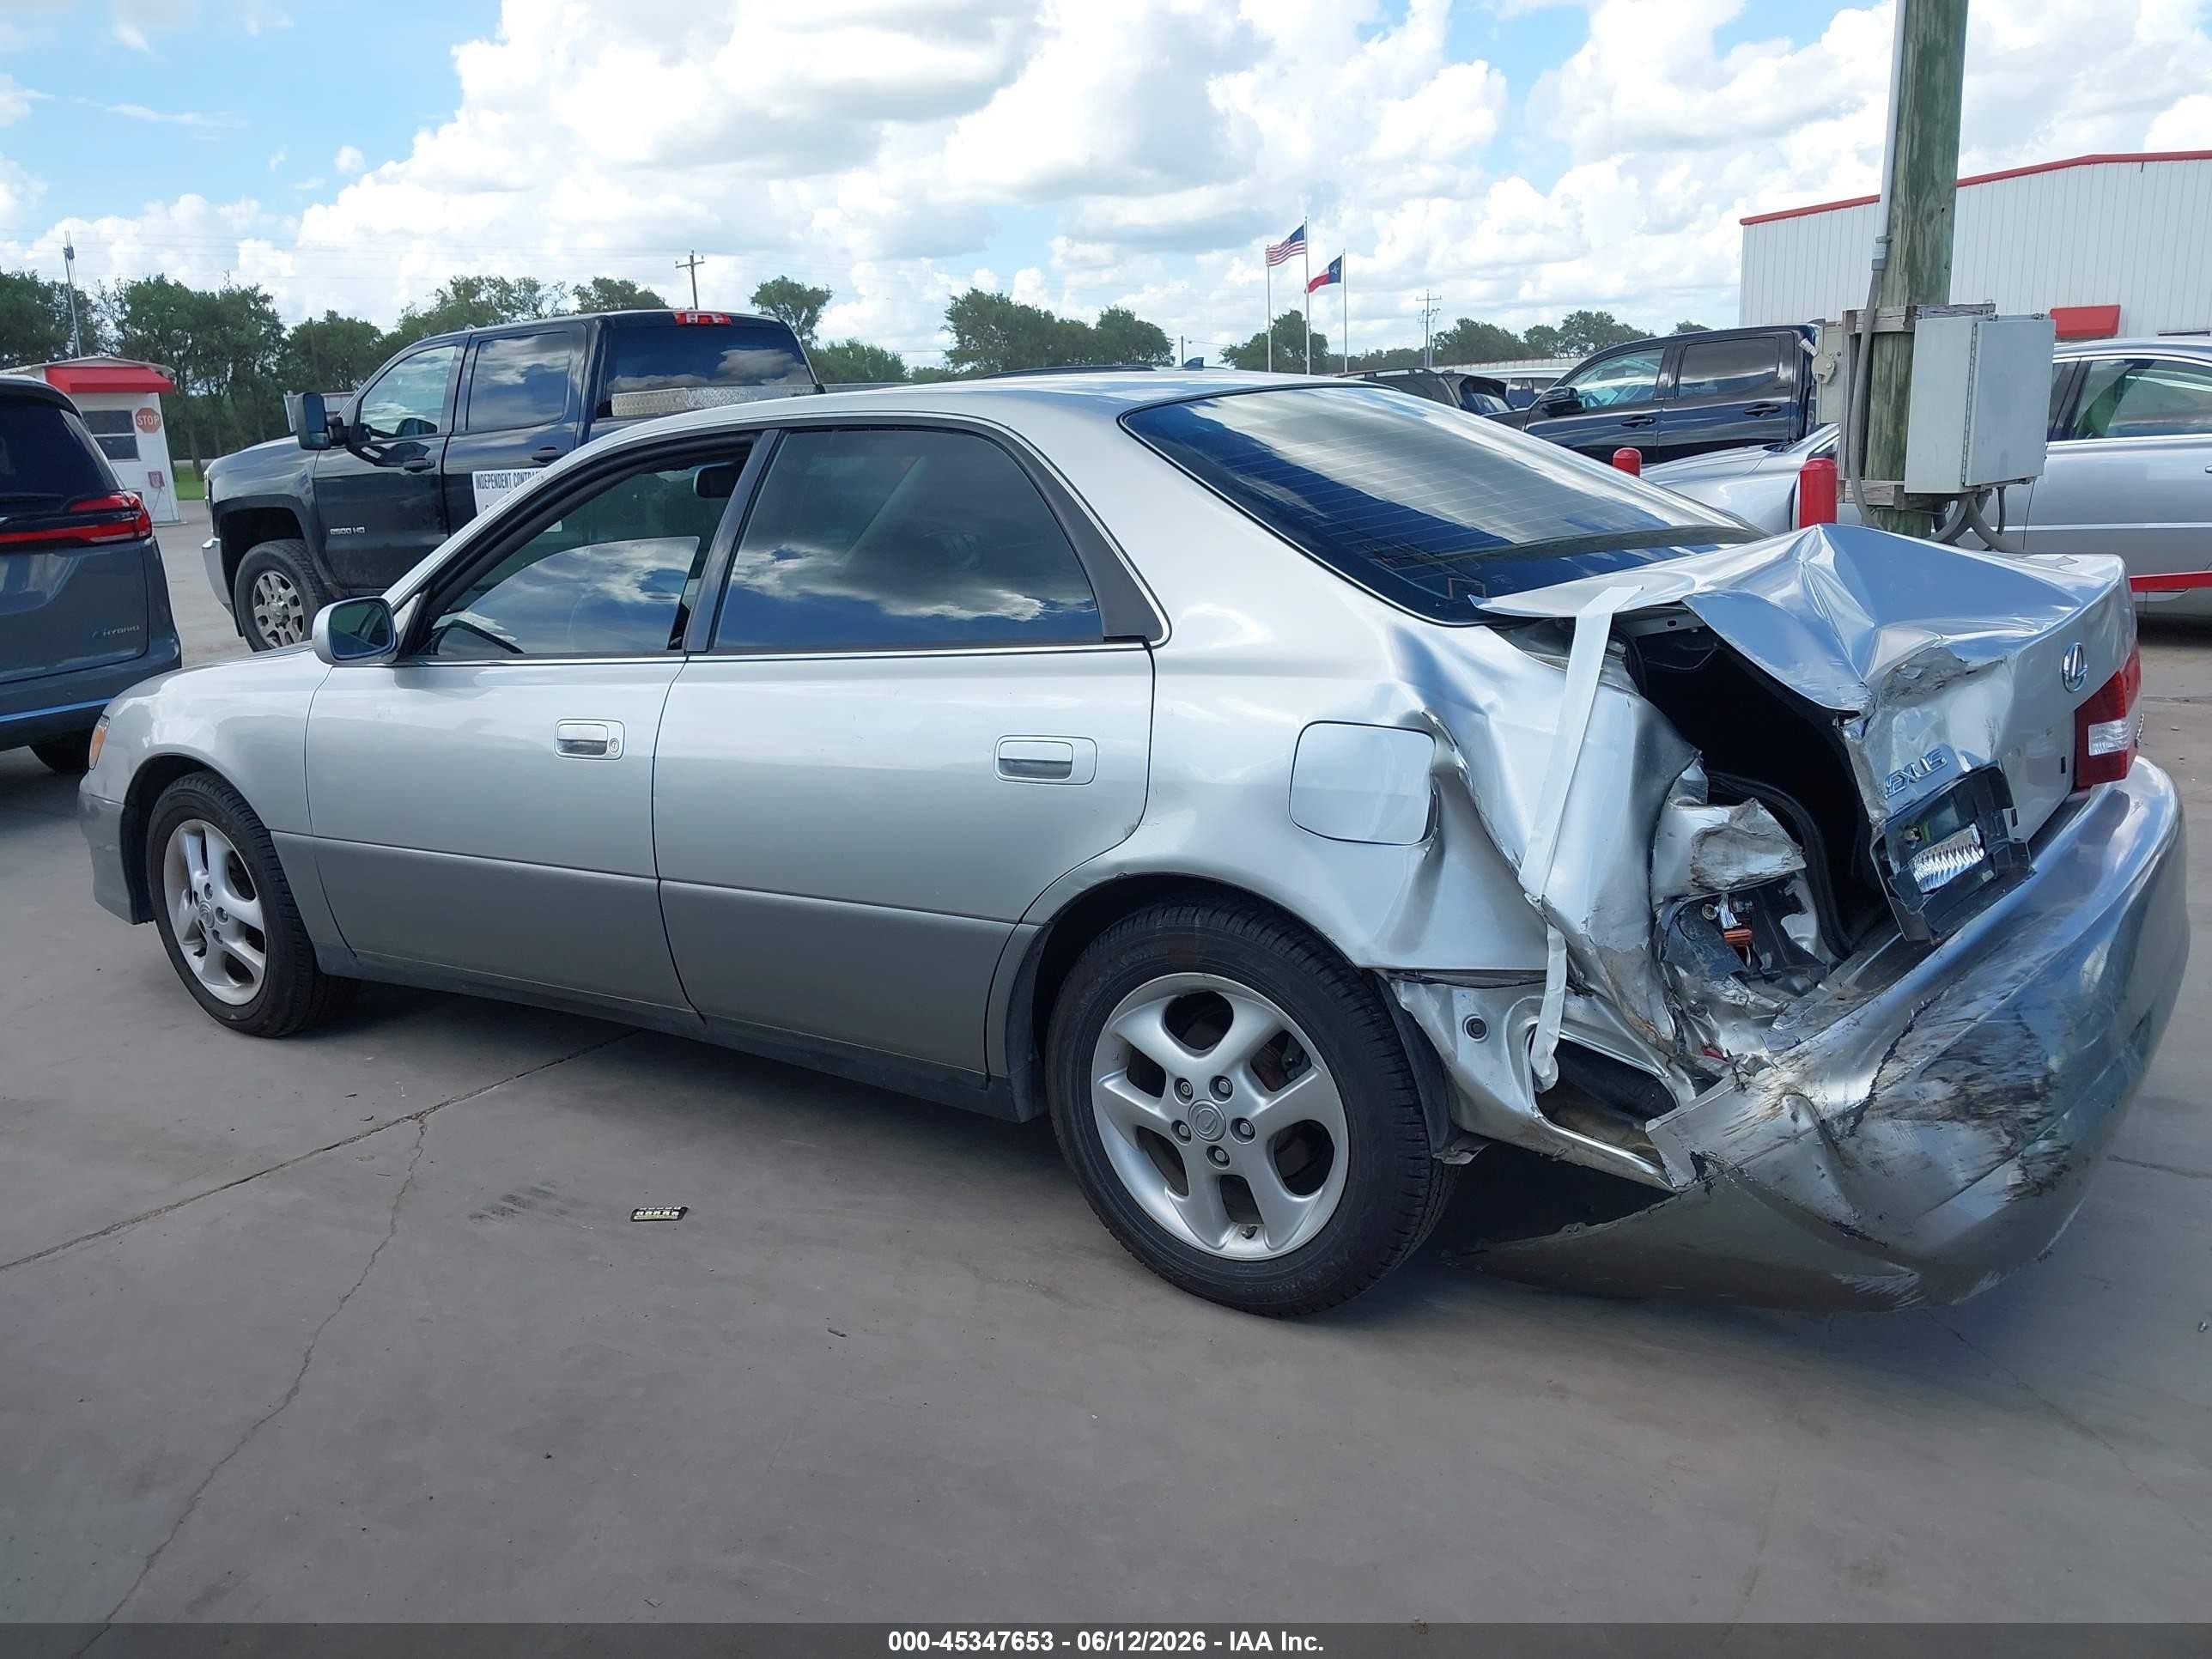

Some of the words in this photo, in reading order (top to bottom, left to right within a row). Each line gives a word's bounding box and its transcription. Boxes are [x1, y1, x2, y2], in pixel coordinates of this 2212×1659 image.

[137, 415, 160, 426] STOP
[475, 472, 512, 489] INDEPENDENT
[513, 471, 538, 489] CONT
